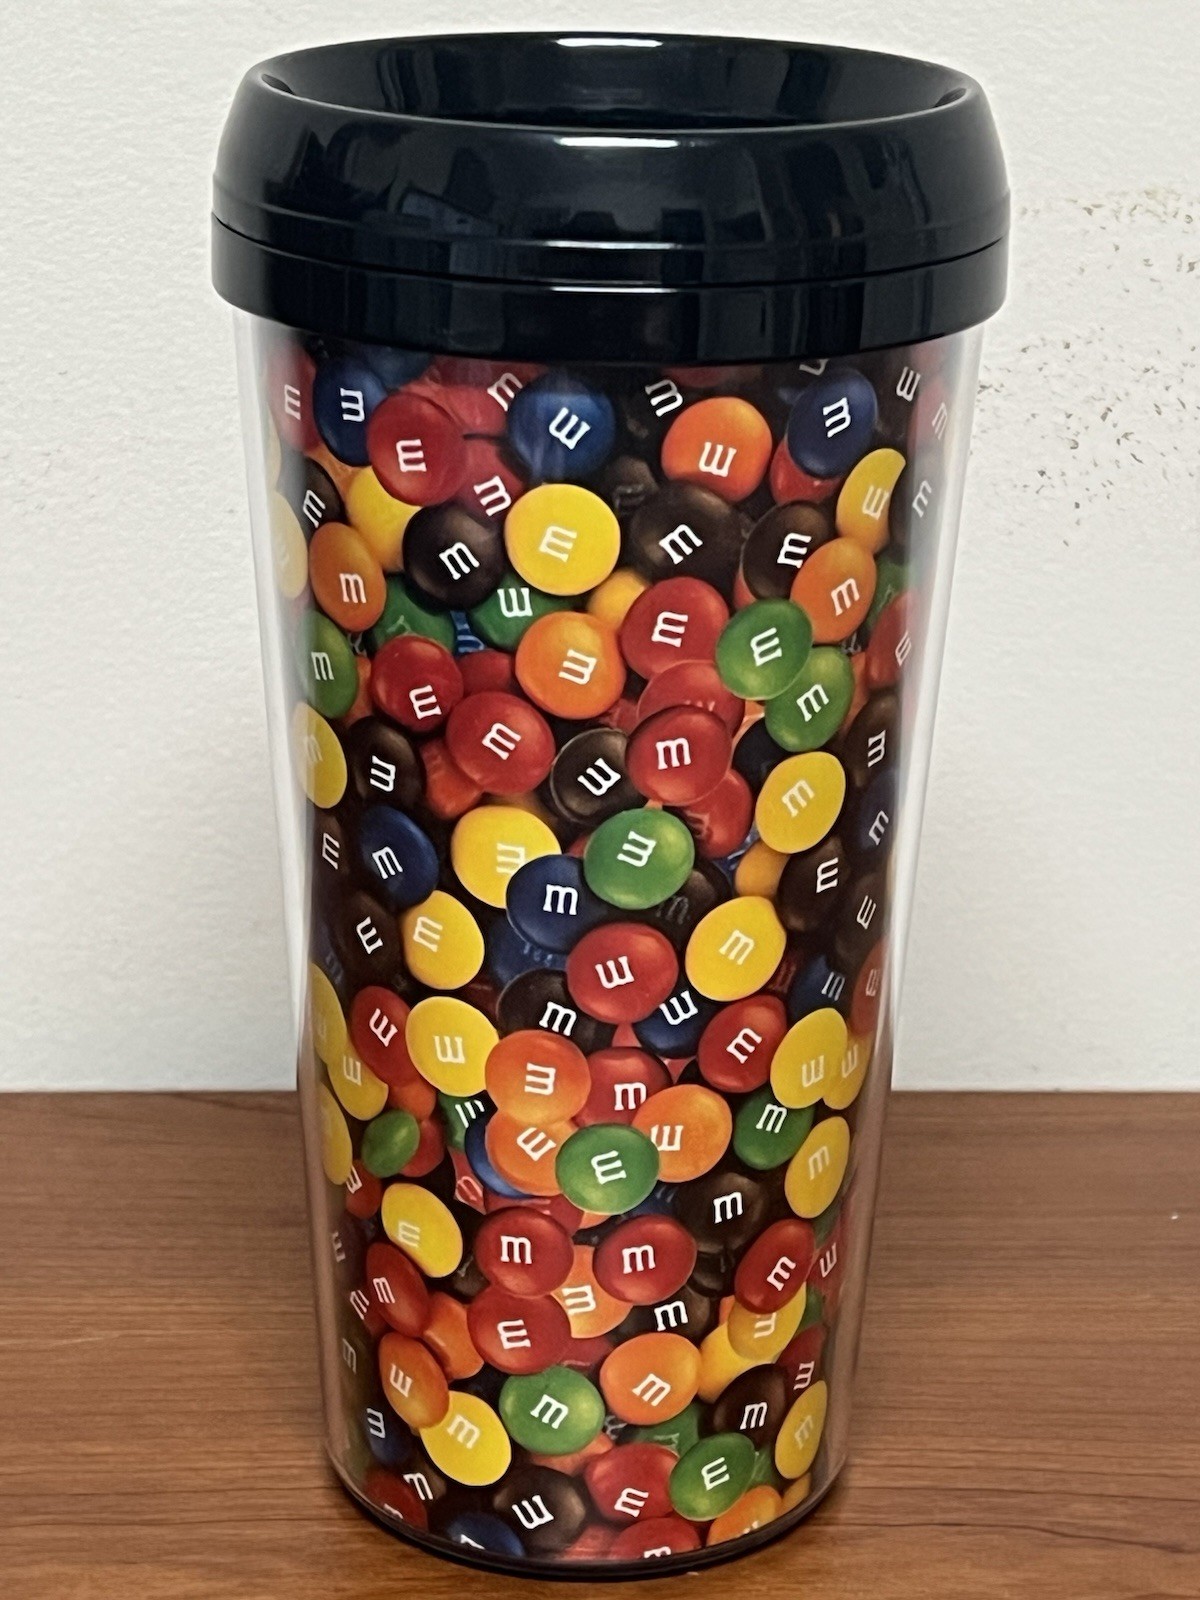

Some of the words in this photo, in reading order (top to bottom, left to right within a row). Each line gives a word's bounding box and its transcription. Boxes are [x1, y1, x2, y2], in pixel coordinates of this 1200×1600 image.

[487, 372, 523, 411] m
[645, 379, 683, 417] m
[896, 366, 921, 401] m
[284, 384, 300, 420] m
[340, 388, 365, 422] m
[823, 397, 851, 438] m
[549, 407, 591, 450] m
[396, 439, 426, 472] m
[699, 441, 737, 477] m
[303, 490, 326, 528] m
[473, 476, 511, 516] m
[862, 485, 889, 520] m
[912, 480, 932, 518] m
[439, 542, 480, 580] m
[538, 525, 577, 562] m
[659, 524, 703, 565] m
[777, 532, 812, 568] m
[339, 573, 366, 603] m
[497, 587, 533, 618] m
[830, 578, 860, 616] m
[651, 611, 688, 648] m
[750, 627, 782, 667] m
[311, 652, 334, 680] m
[895, 630, 911, 667] m
[558, 649, 597, 685] m
[409, 685, 441, 719] m
[796, 683, 830, 722] m
[481, 722, 522, 760] m
[655, 737, 691, 770] m
[868, 730, 886, 768] m
[370, 755, 396, 792] m
[577, 758, 621, 796] m
[781, 779, 816, 818] m
[868, 810, 889, 845] m
[322, 832, 340, 870] m
[372, 846, 403, 880] m
[617, 831, 657, 867] m
[816, 857, 839, 893] m
[542, 884, 578, 915] m
[856, 895, 876, 929] m
[356, 916, 383, 954] m
[413, 916, 443, 952] m
[719, 929, 755, 965] m
[595, 956, 634, 989] m
[539, 1001, 577, 1036] m
[659, 990, 698, 1026] m
[369, 1008, 398, 1047] m
[433, 1035, 465, 1064] m
[726, 1027, 762, 1064] m
[524, 1062, 556, 1095] m
[801, 1055, 825, 1088] m
[614, 1082, 647, 1111] m
[756, 1103, 788, 1133] m
[516, 1127, 556, 1161] m
[650, 1124, 684, 1151] m
[591, 1150, 626, 1185] m
[808, 1146, 830, 1181] m
[713, 1191, 743, 1223] m
[397, 1220, 421, 1248] m
[501, 1235, 532, 1265] m
[622, 1244, 656, 1274] m
[767, 1256, 796, 1292] m
[819, 1243, 837, 1278] m
[372, 1277, 396, 1304] m
[562, 1285, 596, 1316] m
[654, 1300, 688, 1332] m
[497, 1319, 531, 1349] m
[389, 1363, 412, 1398] m
[632, 1373, 671, 1407] m
[794, 1360, 815, 1390] m
[366, 1408, 385, 1439] m
[530, 1394, 569, 1430] m
[740, 1401, 768, 1430] m
[447, 1414, 481, 1449] m
[701, 1457, 730, 1491] m
[512, 1495, 554, 1530] m
[614, 1487, 649, 1518] m
